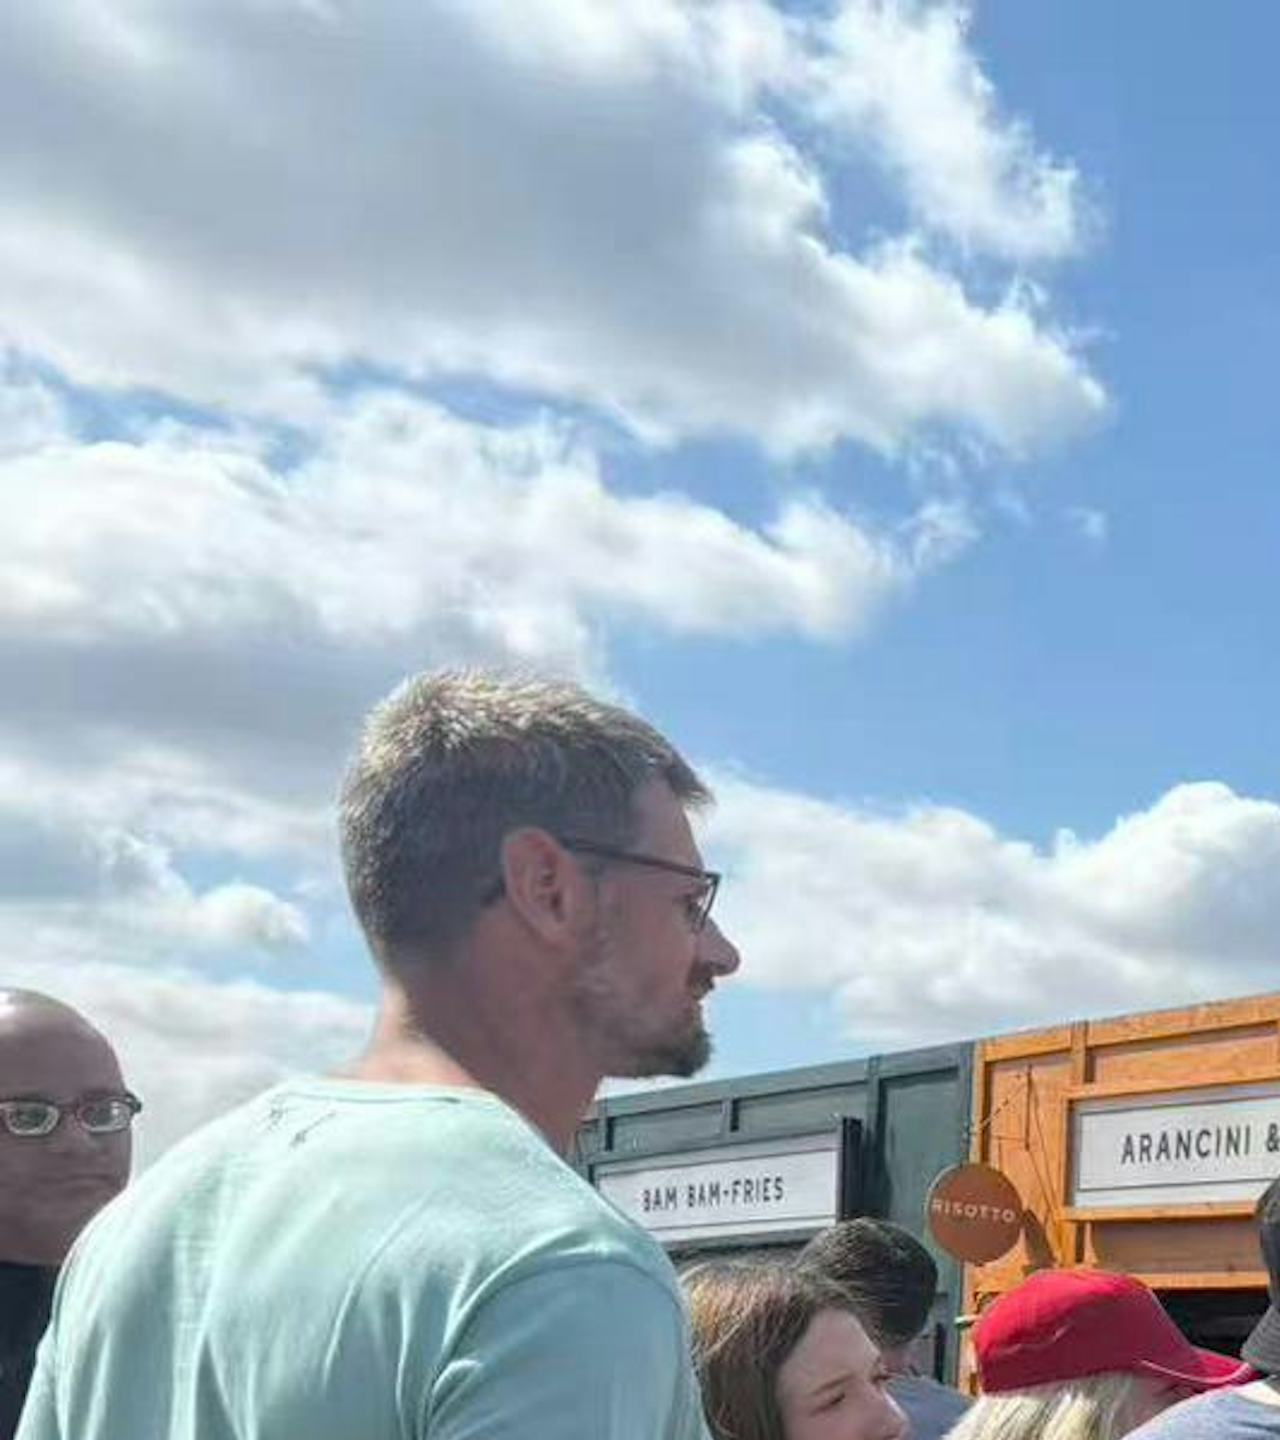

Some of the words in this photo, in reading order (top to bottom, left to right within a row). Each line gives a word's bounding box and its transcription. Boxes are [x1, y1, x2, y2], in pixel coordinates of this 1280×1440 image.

[1120, 1127, 1251, 1165] ARANCINI
[1266, 1122, 1280, 1152] &
[642, 1186, 678, 1212] BAM
[931, 1198, 1016, 1223] RISOTTO
